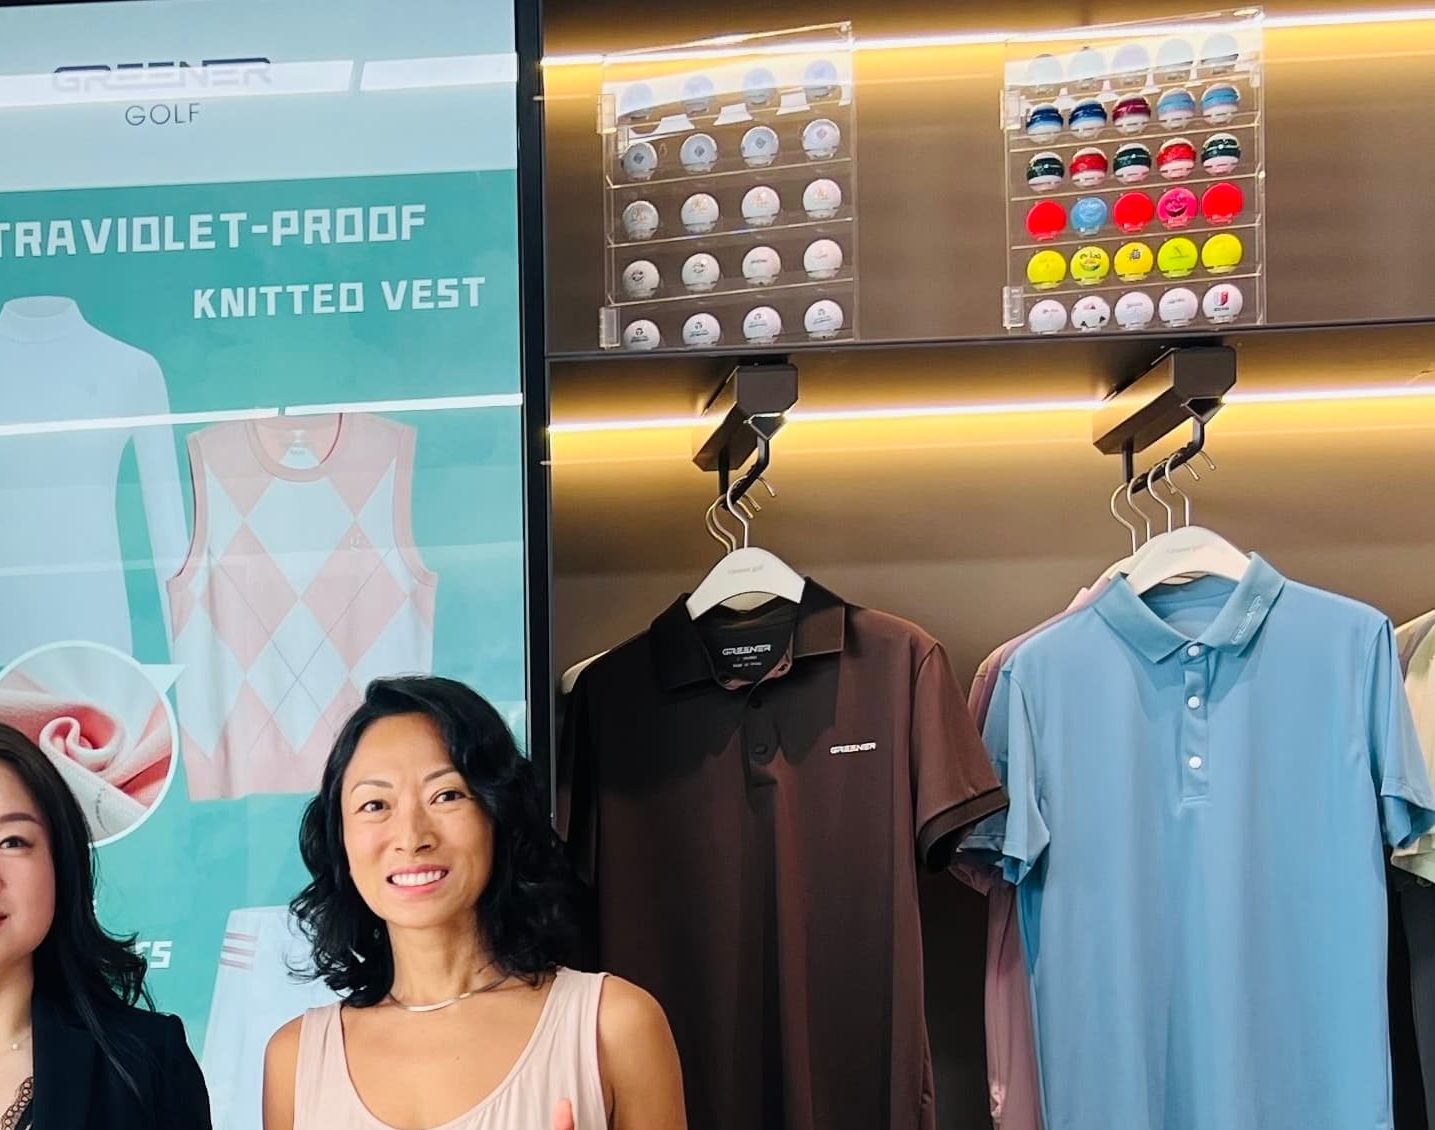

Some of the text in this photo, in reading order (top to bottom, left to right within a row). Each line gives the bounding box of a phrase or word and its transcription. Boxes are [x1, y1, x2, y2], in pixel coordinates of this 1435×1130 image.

[52, 57, 272, 93] GREENER
[124, 102, 200, 127] GOLF
[193, 276, 487, 321] KNITTED VEST
